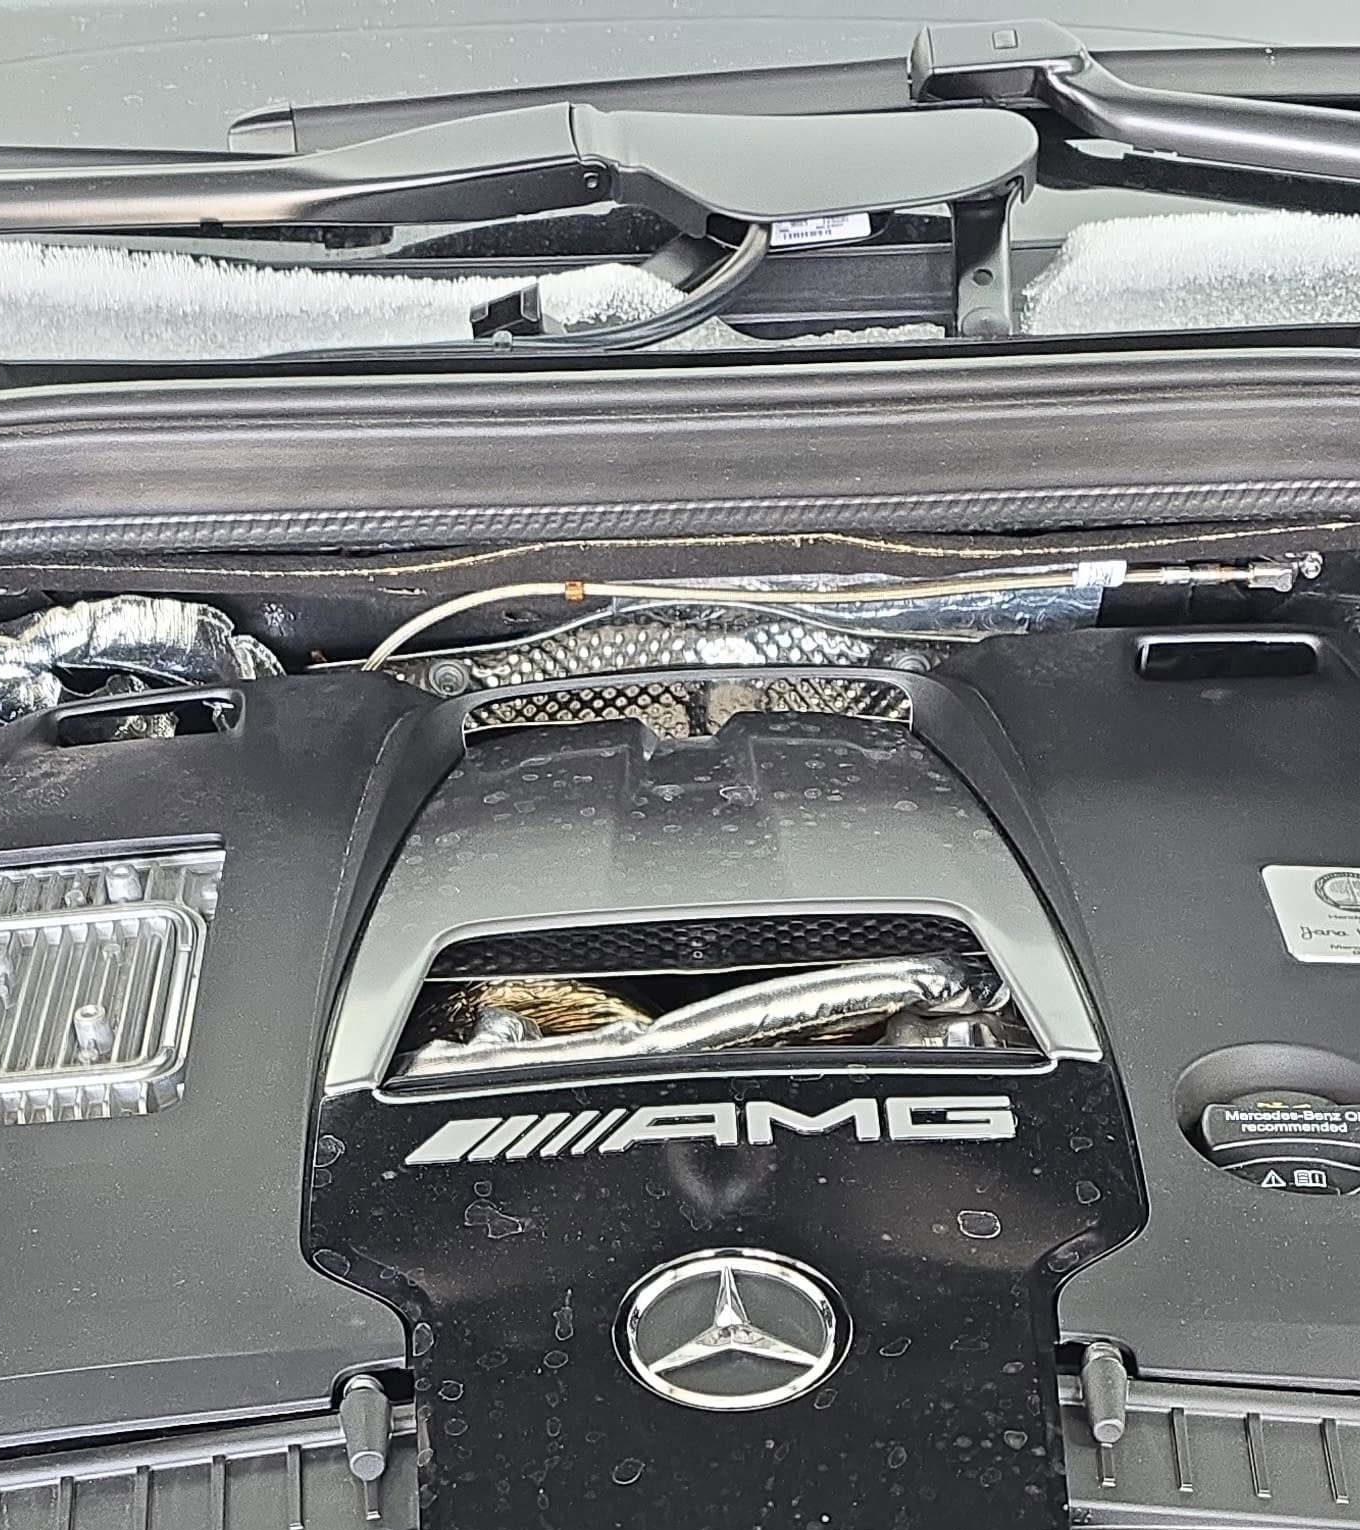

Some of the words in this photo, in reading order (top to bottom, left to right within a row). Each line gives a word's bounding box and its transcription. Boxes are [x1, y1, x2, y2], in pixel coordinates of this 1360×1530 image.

[1225, 1110, 1341, 1122] Mercedes-Benz
[599, 1095, 1017, 1154] AMG
[1241, 1121, 1348, 1134] recommended
